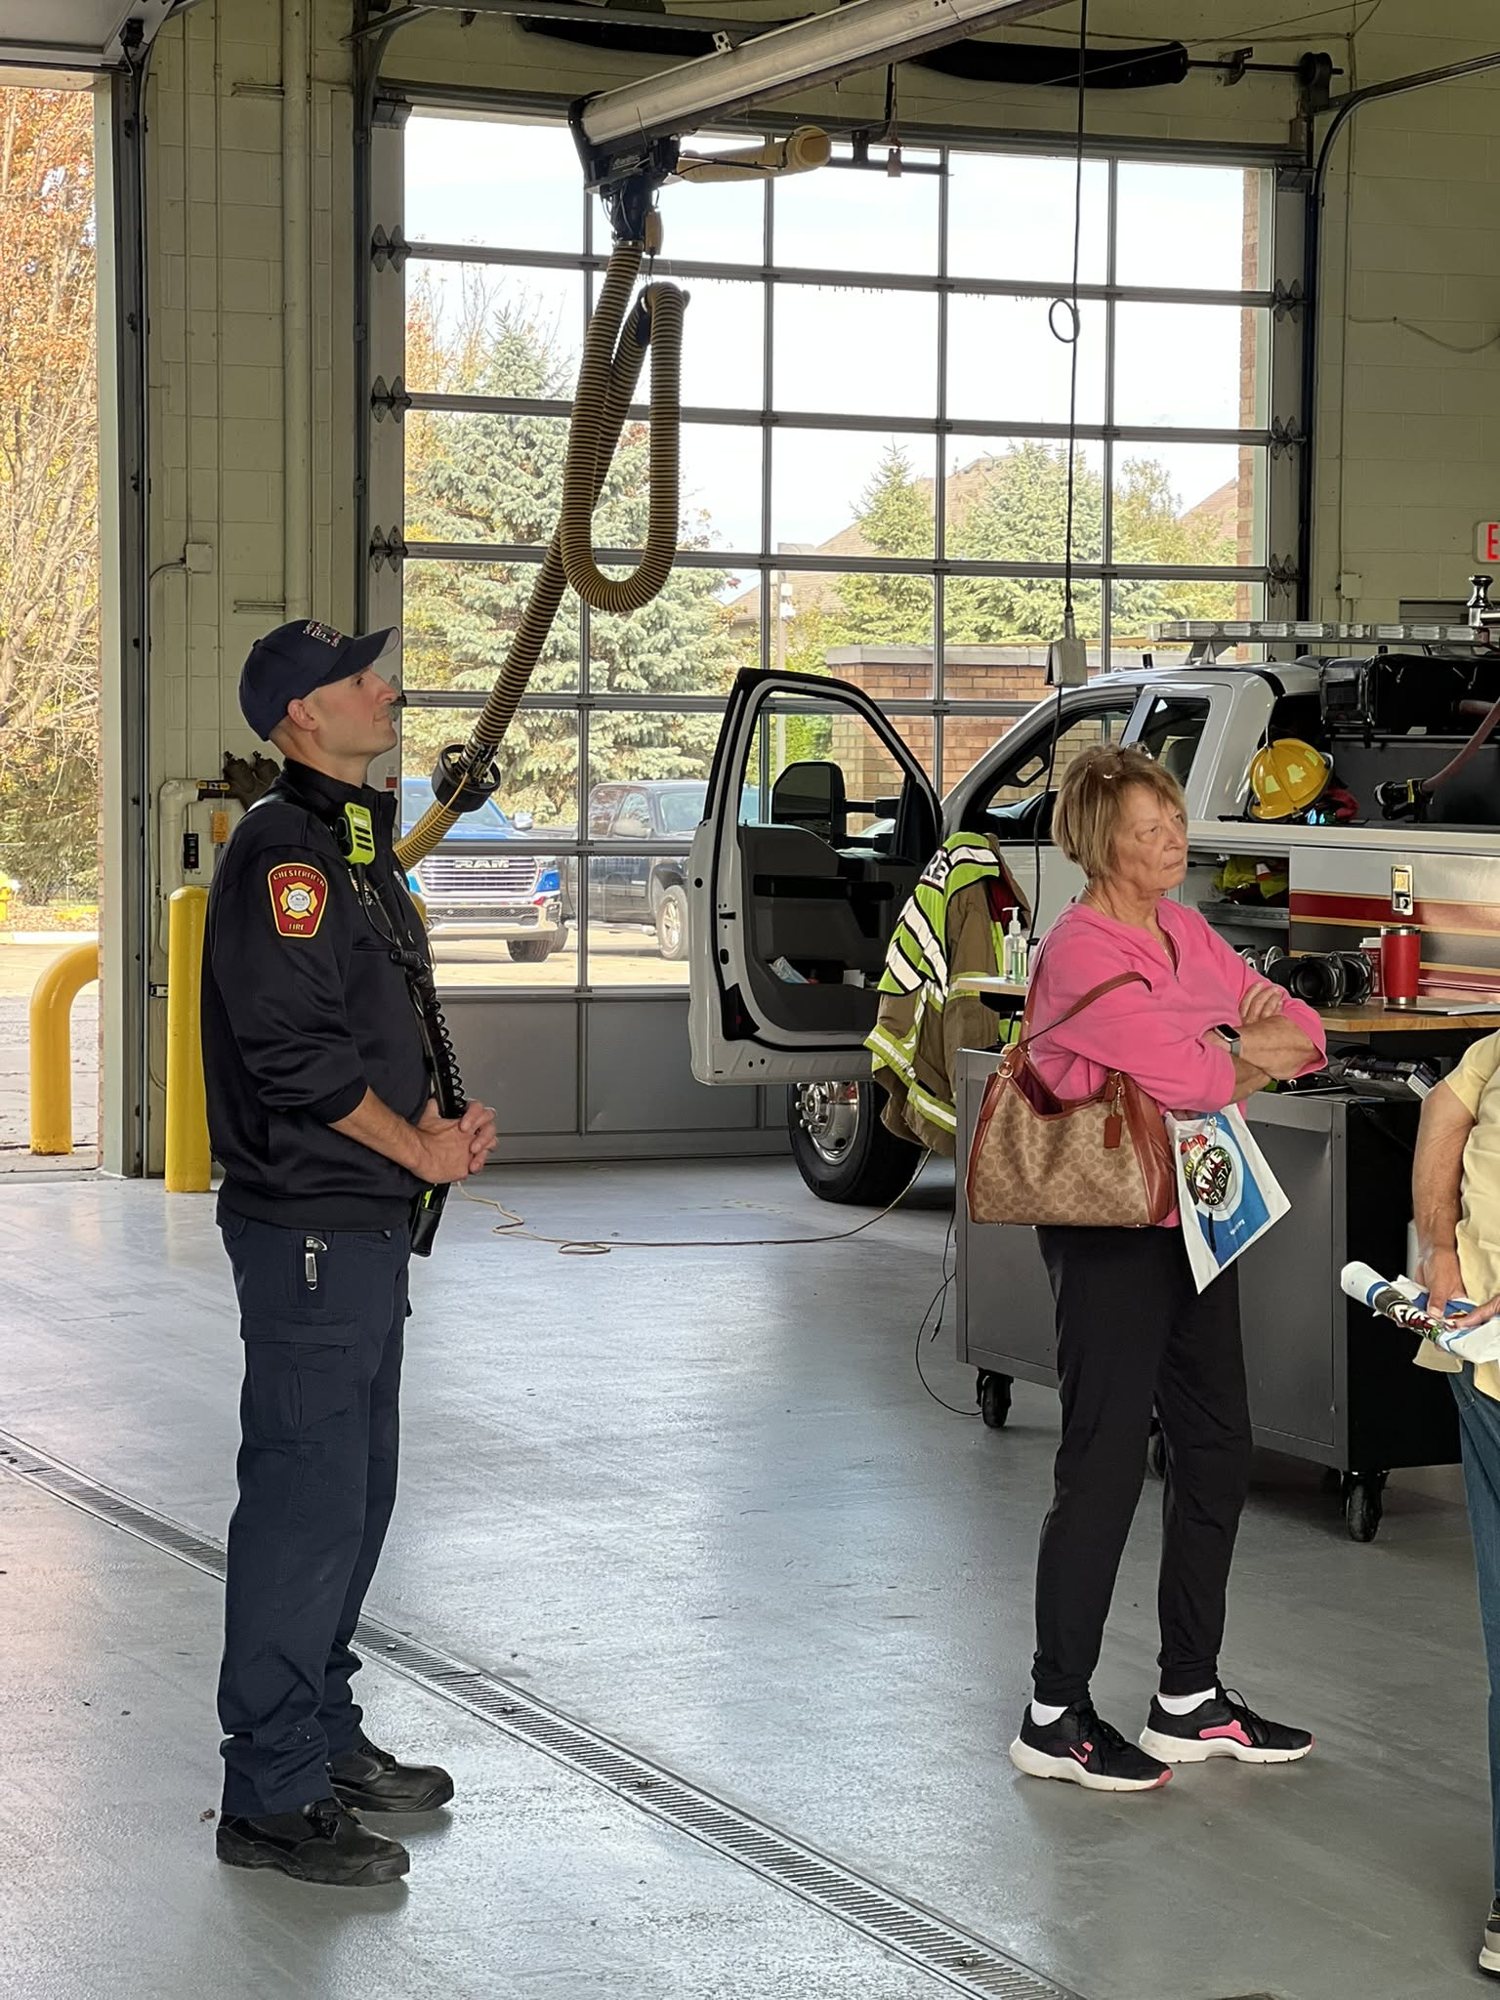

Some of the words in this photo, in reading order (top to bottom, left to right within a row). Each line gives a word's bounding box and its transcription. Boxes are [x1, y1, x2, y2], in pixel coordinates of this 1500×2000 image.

[454, 859, 510, 869] RAM
[288, 923, 305, 931] FIRE
[1196, 1149, 1224, 1189] FIRE
